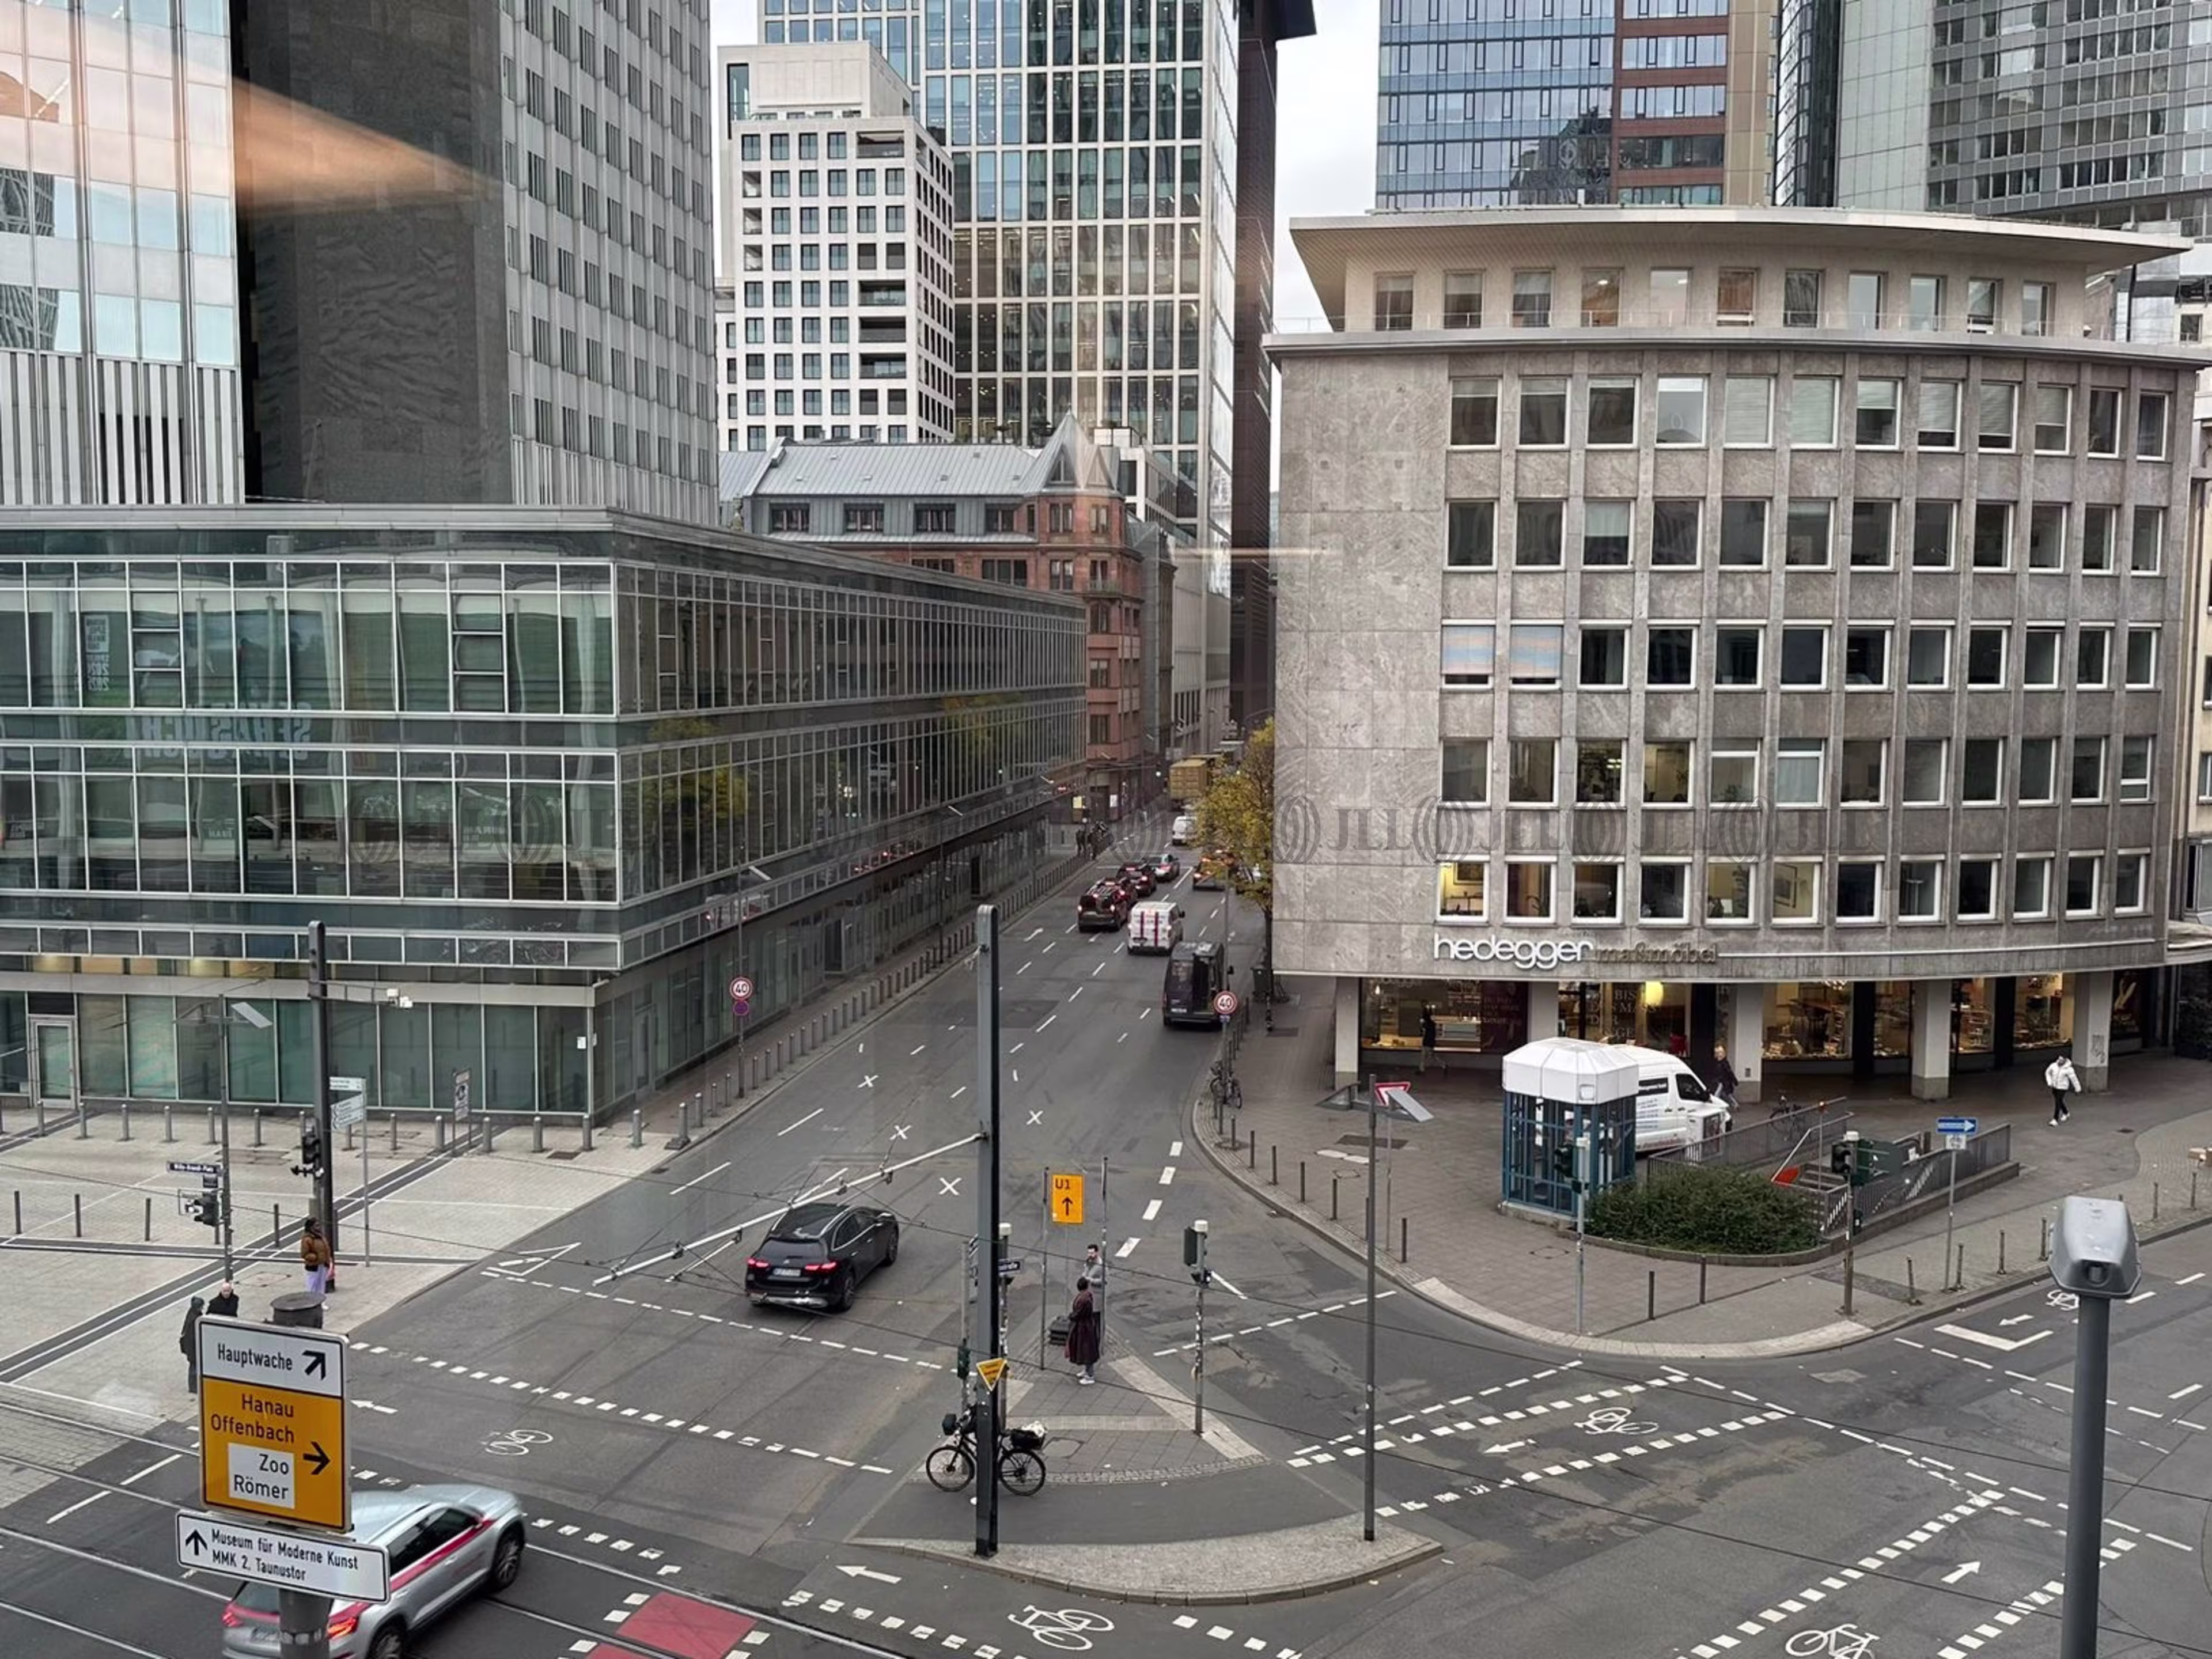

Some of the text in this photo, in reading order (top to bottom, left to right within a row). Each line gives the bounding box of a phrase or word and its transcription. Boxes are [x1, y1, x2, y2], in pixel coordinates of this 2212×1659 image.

[1434, 933, 1594, 969] hedegger
[735, 983, 748, 993] 40
[1219, 997, 1232, 1008] 40
[1055, 1178, 1070, 1190] U1
[217, 1343, 293, 1370] Hauptwache
[241, 1393, 294, 1418] Hanau
[211, 1414, 294, 1444] Offenbach
[259, 1453, 289, 1475] Zoo
[234, 1474, 289, 1499] Römer
[211, 1529, 358, 1570] Museum für Moderne Kunst
[212, 1550, 237, 1567] MMK
[255, 1558, 306, 1581] Taunustor
